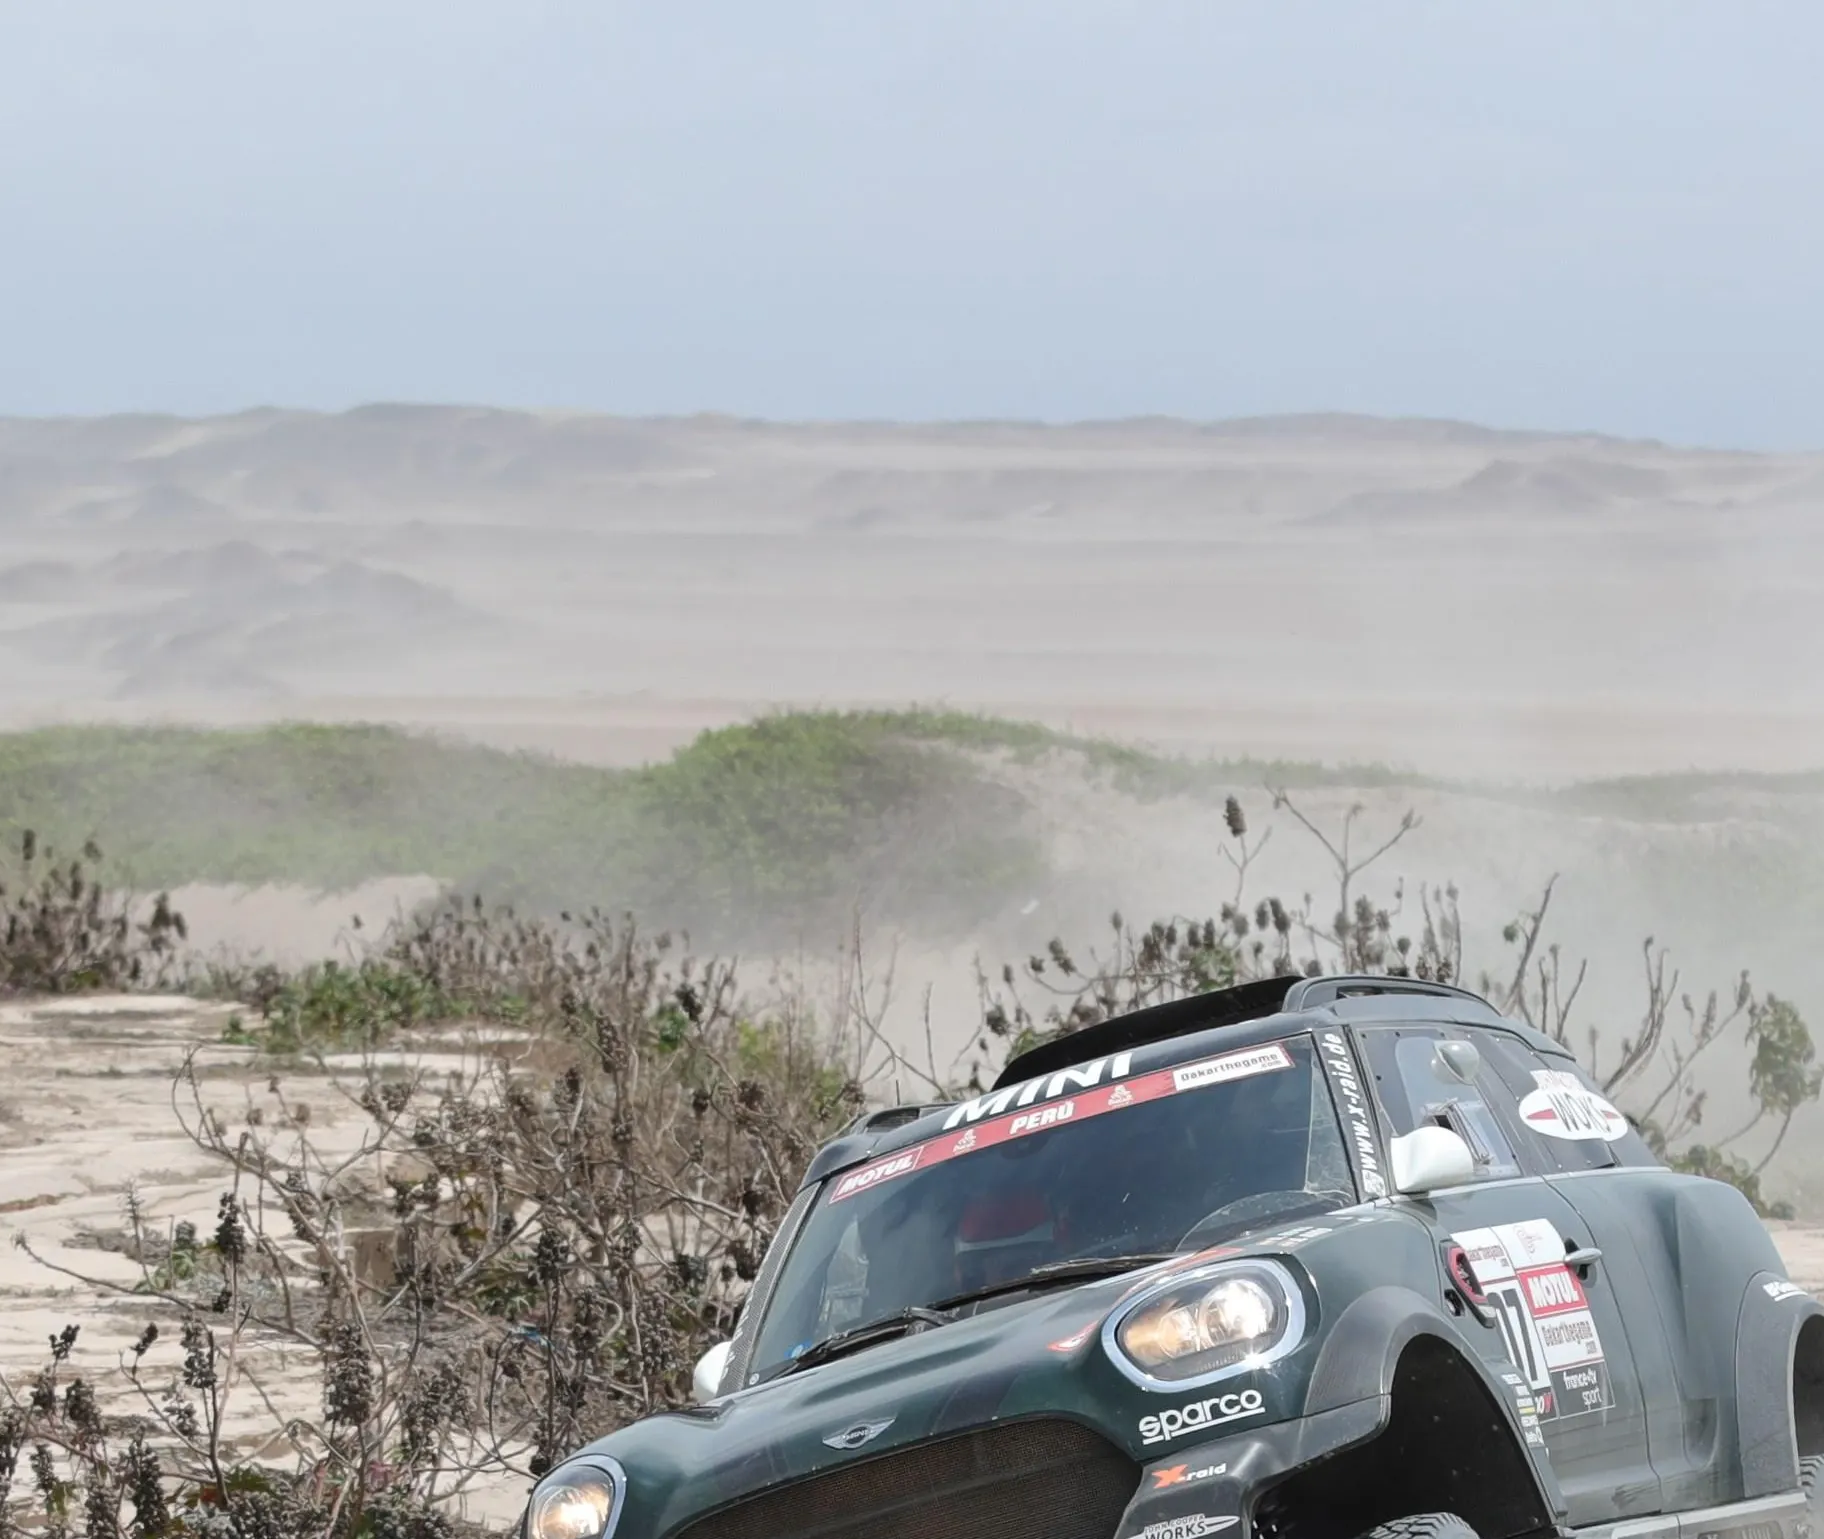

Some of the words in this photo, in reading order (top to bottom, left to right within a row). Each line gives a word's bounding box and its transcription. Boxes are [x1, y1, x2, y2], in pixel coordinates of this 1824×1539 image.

[943, 1053, 1132, 1130] MINI
[1181, 1053, 1278, 1082] Dakarthegame
[1322, 1033, 1378, 1170] www.x-raid.de
[837, 1154, 914, 1196] MOTUL
[1528, 1271, 1579, 1308] MOTUL
[1139, 1389, 1266, 1445] sparco
